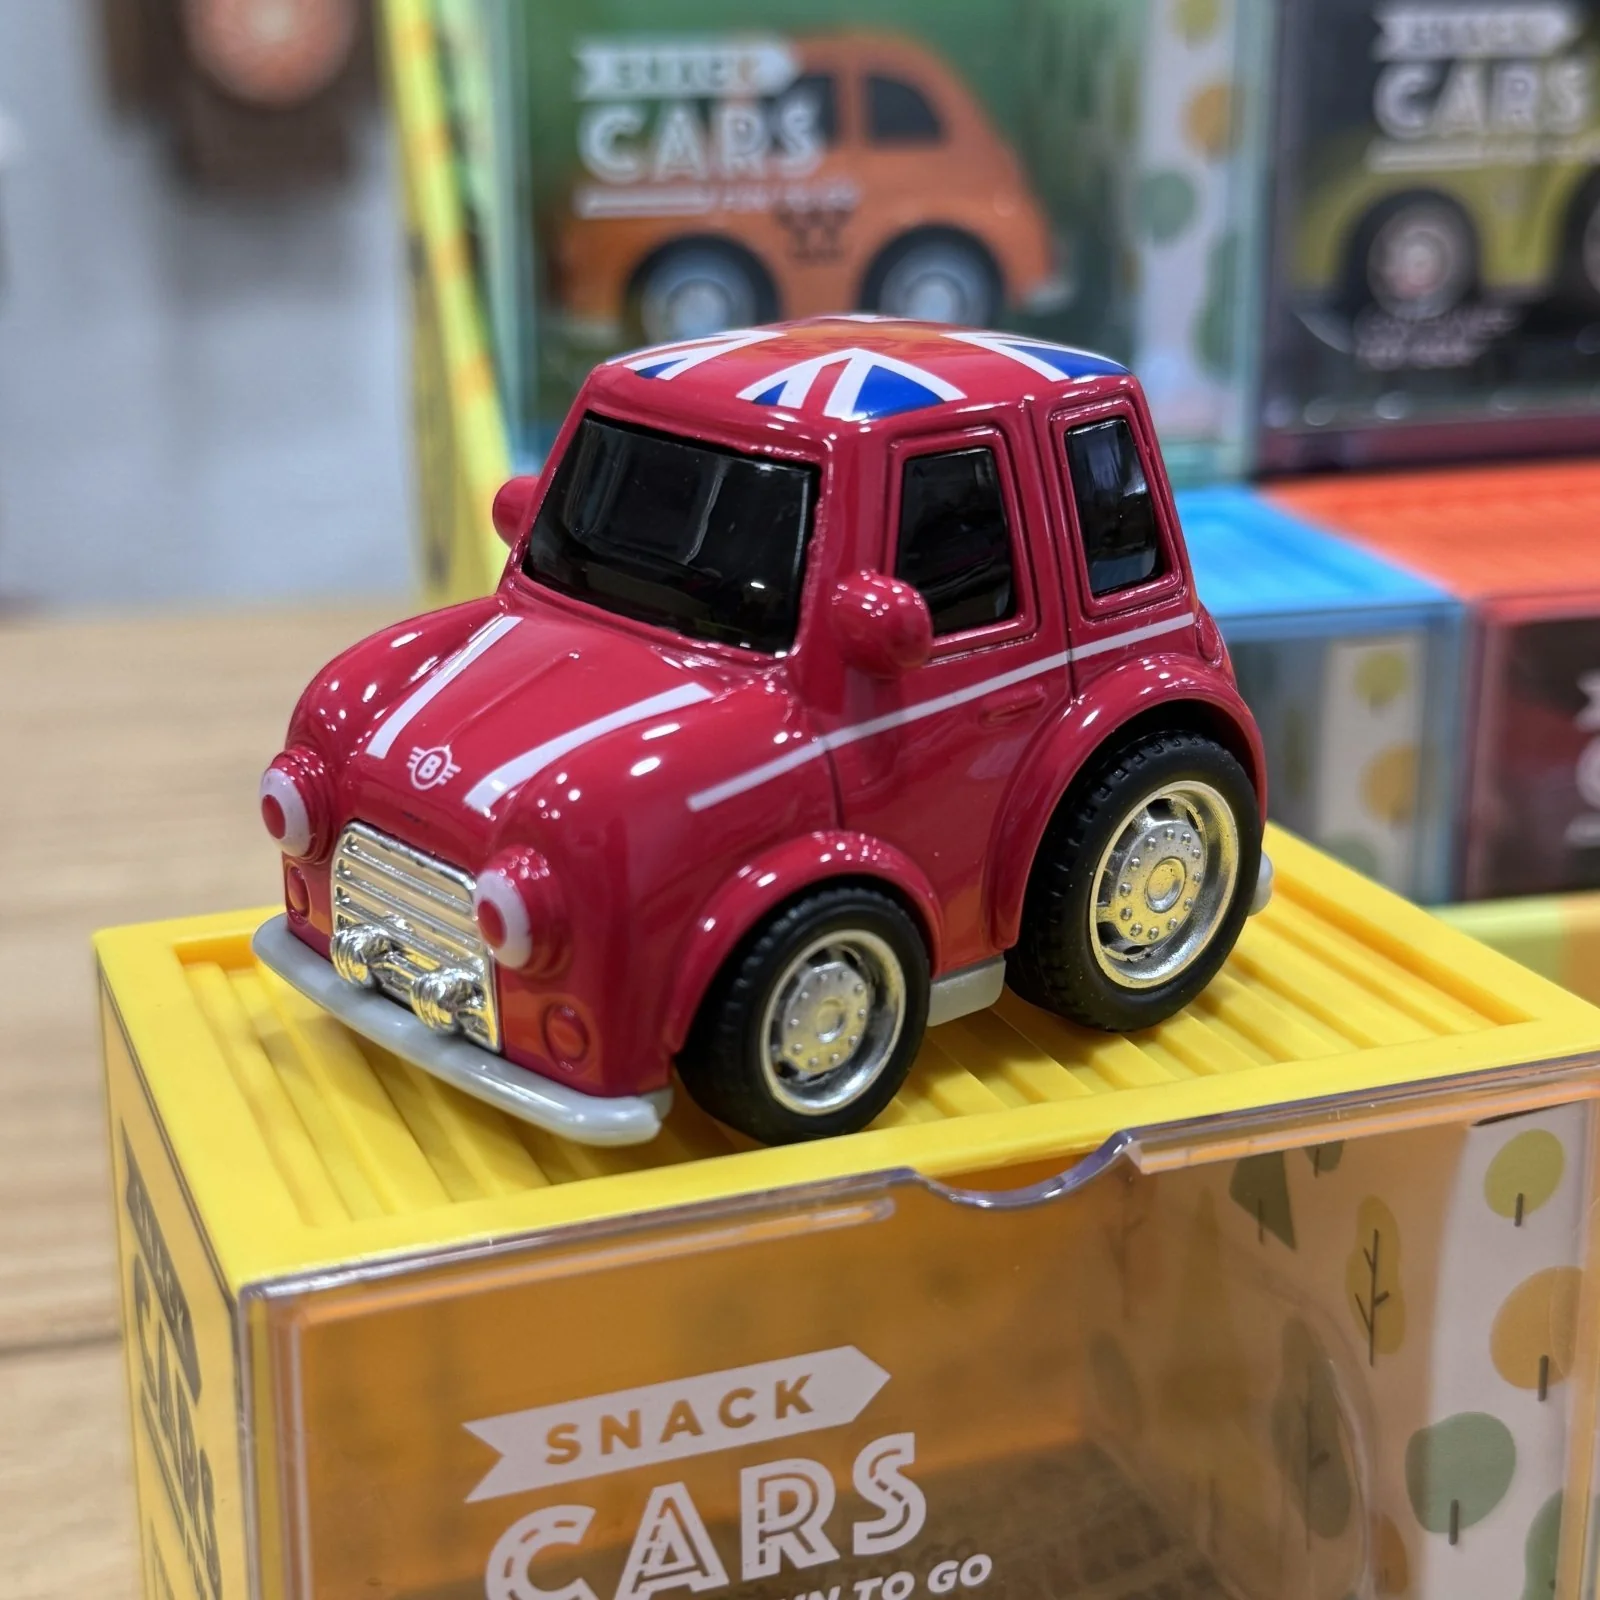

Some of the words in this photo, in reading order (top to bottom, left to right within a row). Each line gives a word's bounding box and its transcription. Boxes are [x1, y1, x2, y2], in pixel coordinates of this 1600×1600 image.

[579, 93, 823, 182] CARS
[1374, 62, 1588, 138] CARS
[135, 1184, 188, 1358] SNACK
[133, 1253, 222, 1600] CARS
[545, 1373, 813, 1465] SNACK
[485, 1432, 926, 1600] CARS
[853, 1571, 915, 1600] TO
[927, 1554, 992, 1594] GO
